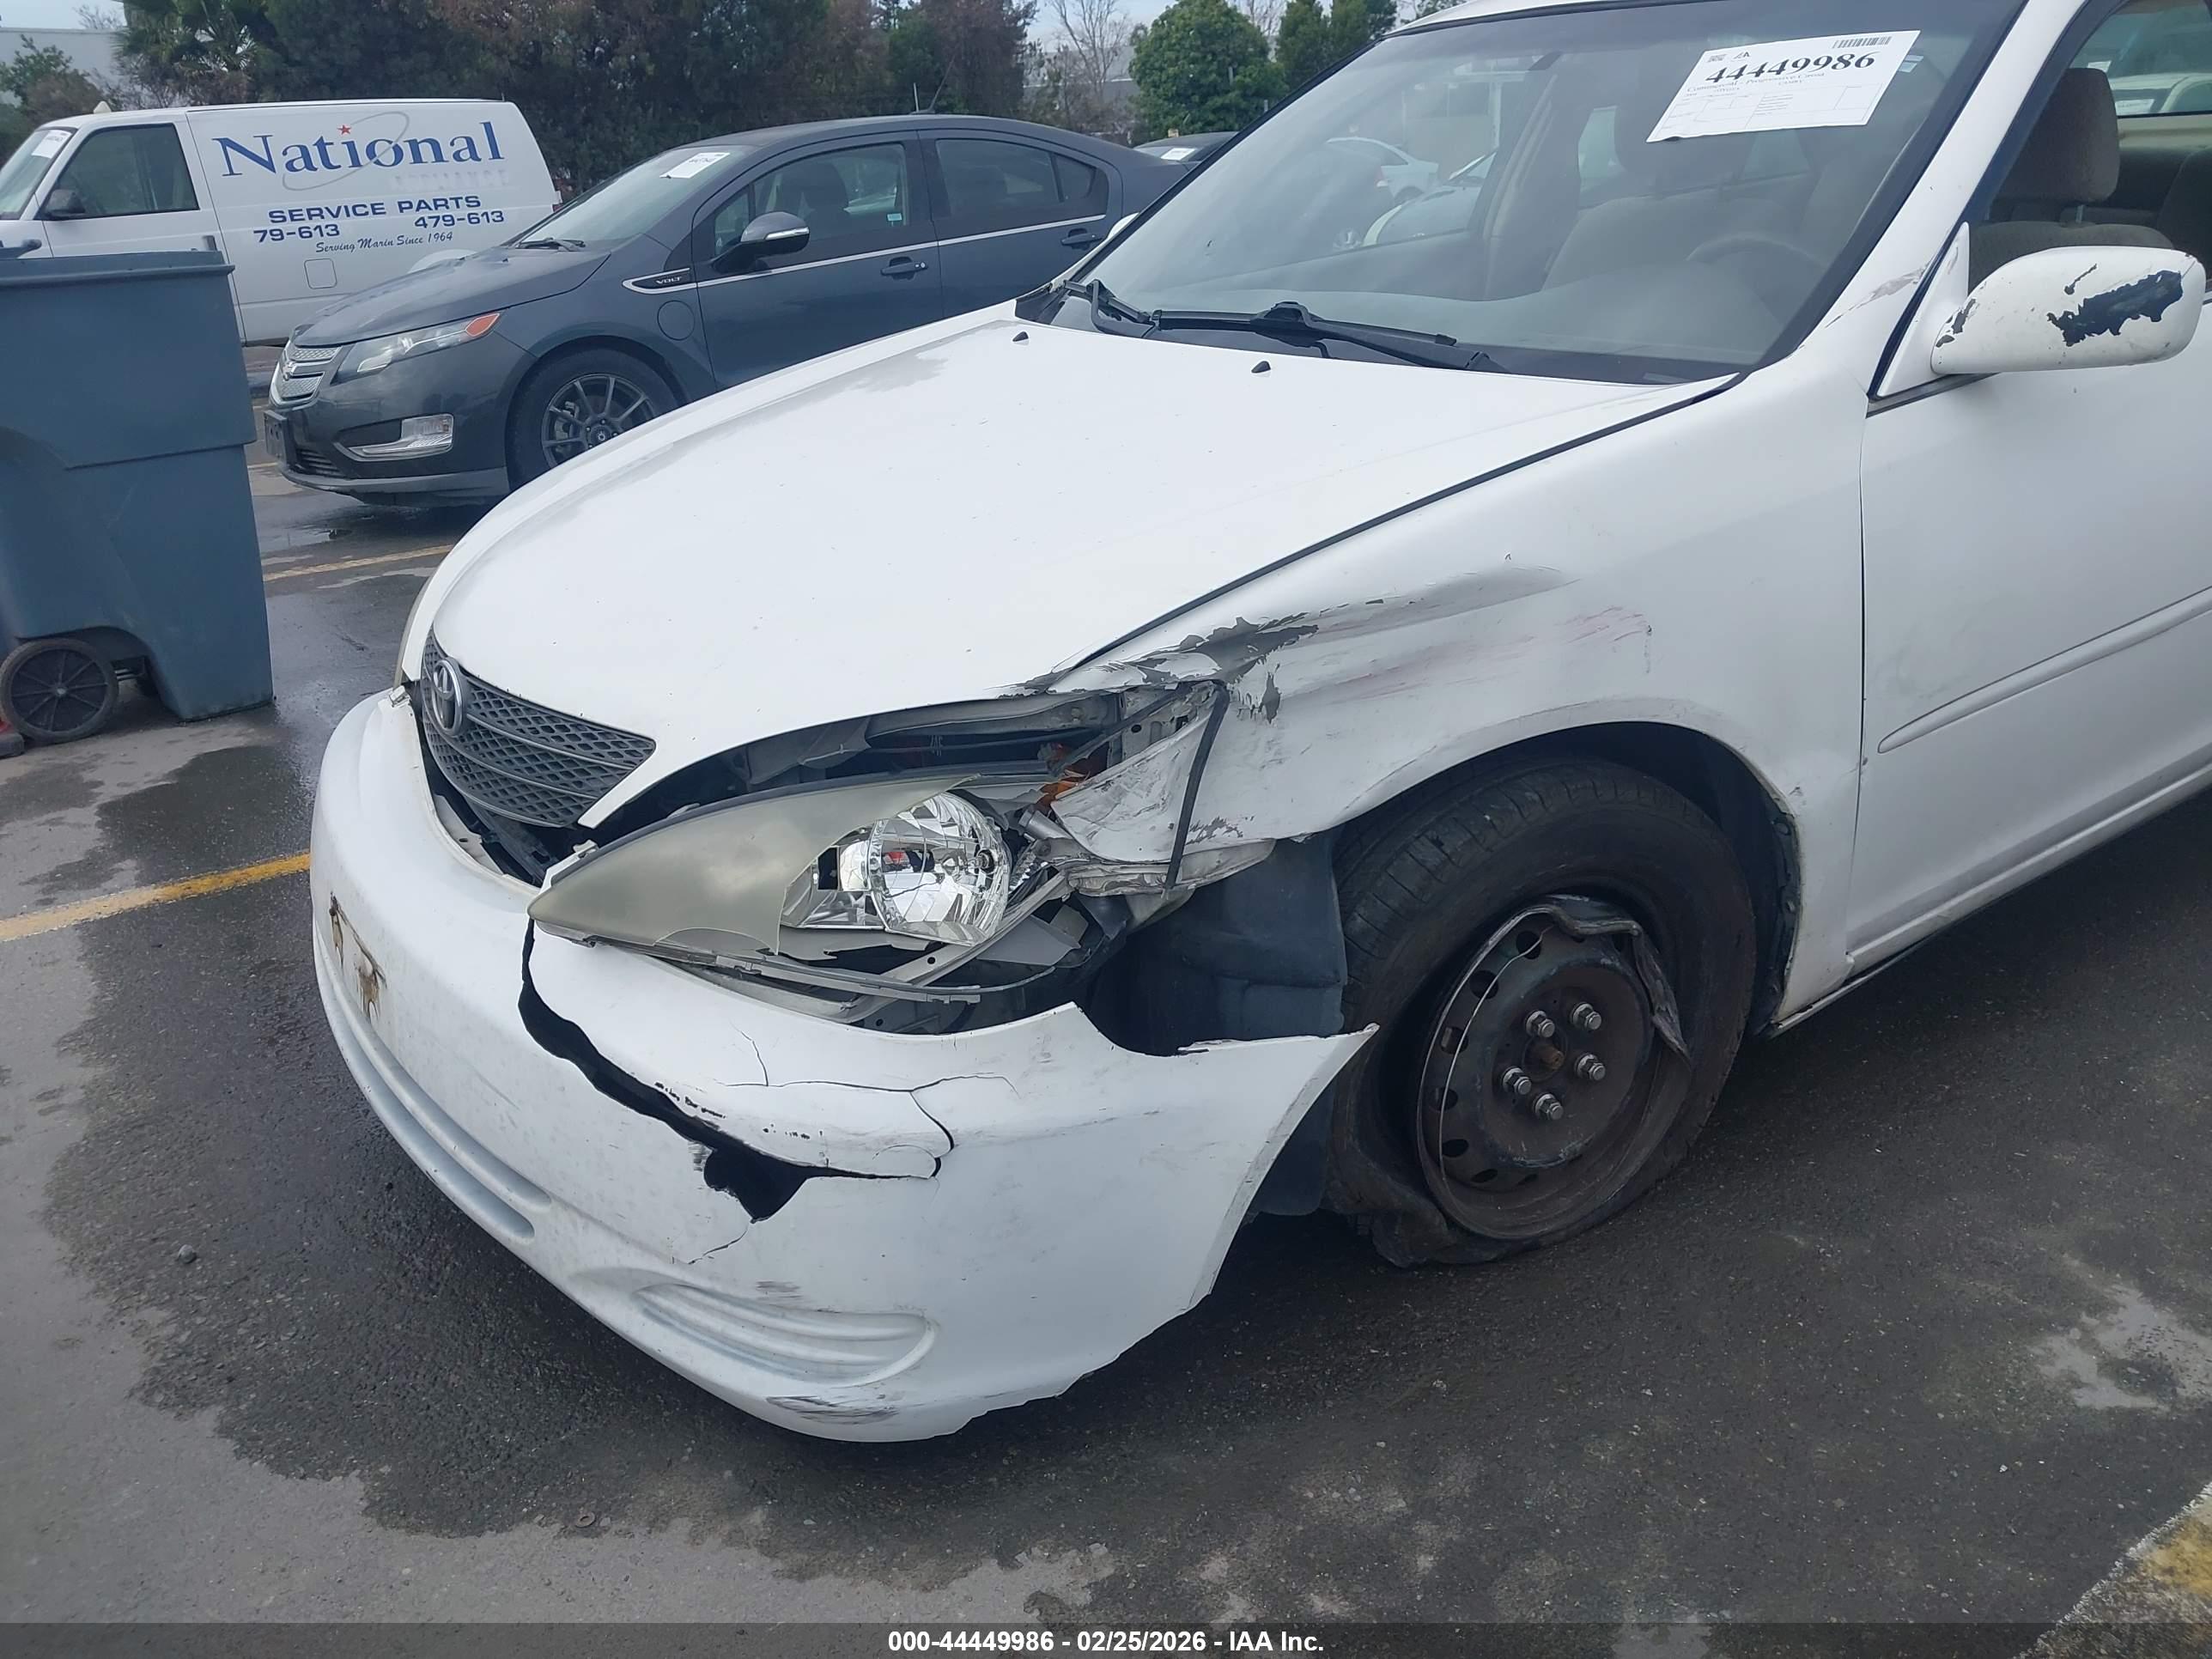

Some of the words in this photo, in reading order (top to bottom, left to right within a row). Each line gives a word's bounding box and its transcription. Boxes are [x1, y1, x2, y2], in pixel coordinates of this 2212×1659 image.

[1705, 51, 1881, 83] 44449986
[211, 120, 505, 177] National
[268, 201, 387, 224] SERVICE
[398, 195, 482, 214] PARTS
[253, 224, 340, 243] 79-613
[414, 210, 505, 229] 479-613
[315, 241, 356, 253] Serving
[357, 237, 394, 250] Marin
[397, 234, 423, 246] Since
[428, 231, 453, 244] 1964
